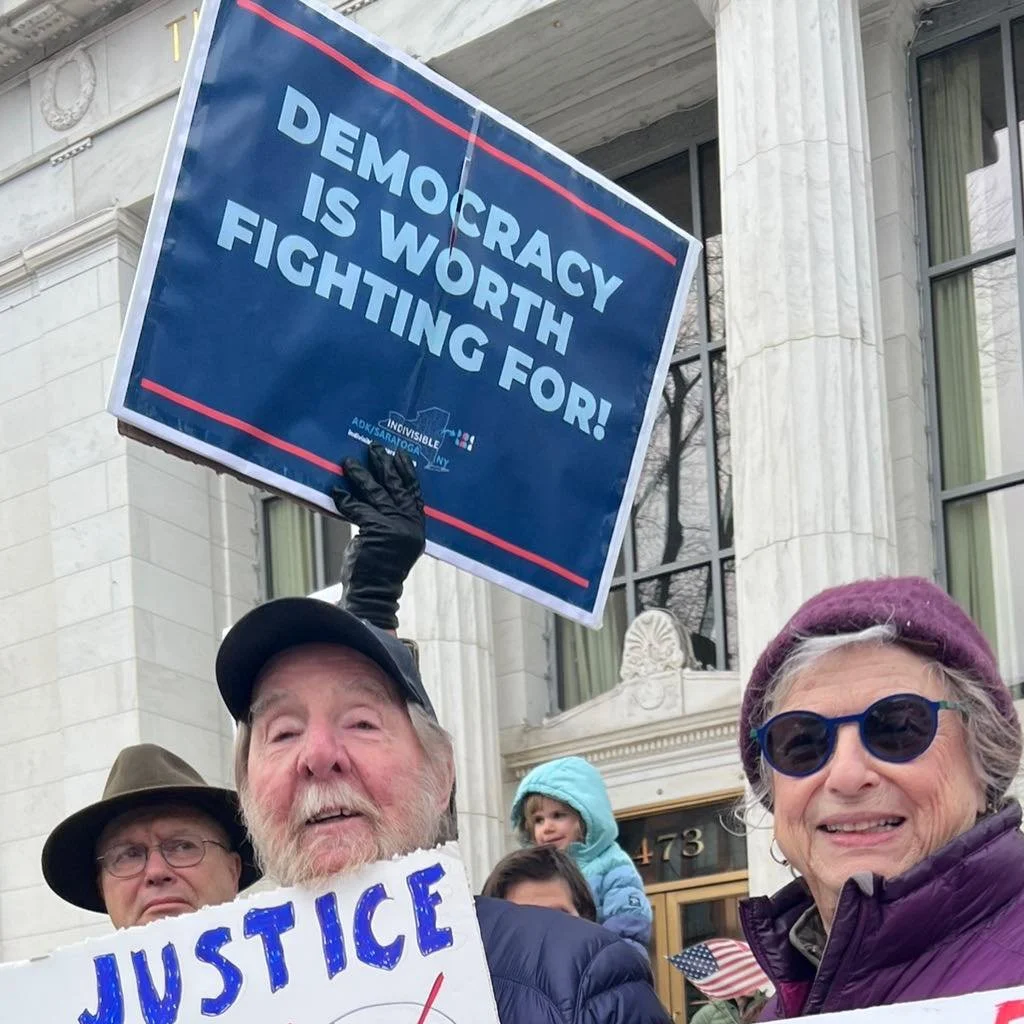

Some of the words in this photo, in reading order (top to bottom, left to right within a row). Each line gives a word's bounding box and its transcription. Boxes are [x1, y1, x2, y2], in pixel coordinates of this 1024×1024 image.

[277, 85, 623, 314] DEMOCRACY
[301, 174, 360, 239] IS
[379, 212, 573, 356] WORTH
[217, 199, 485, 373] FIGHTING
[498, 346, 612, 441] FOR!
[352, 416, 421, 456] ADK/SARATOGA
[387, 418, 441, 450] INDIVISIBLE
[436, 454, 450, 467] NY
[633, 828, 705, 865] 473
